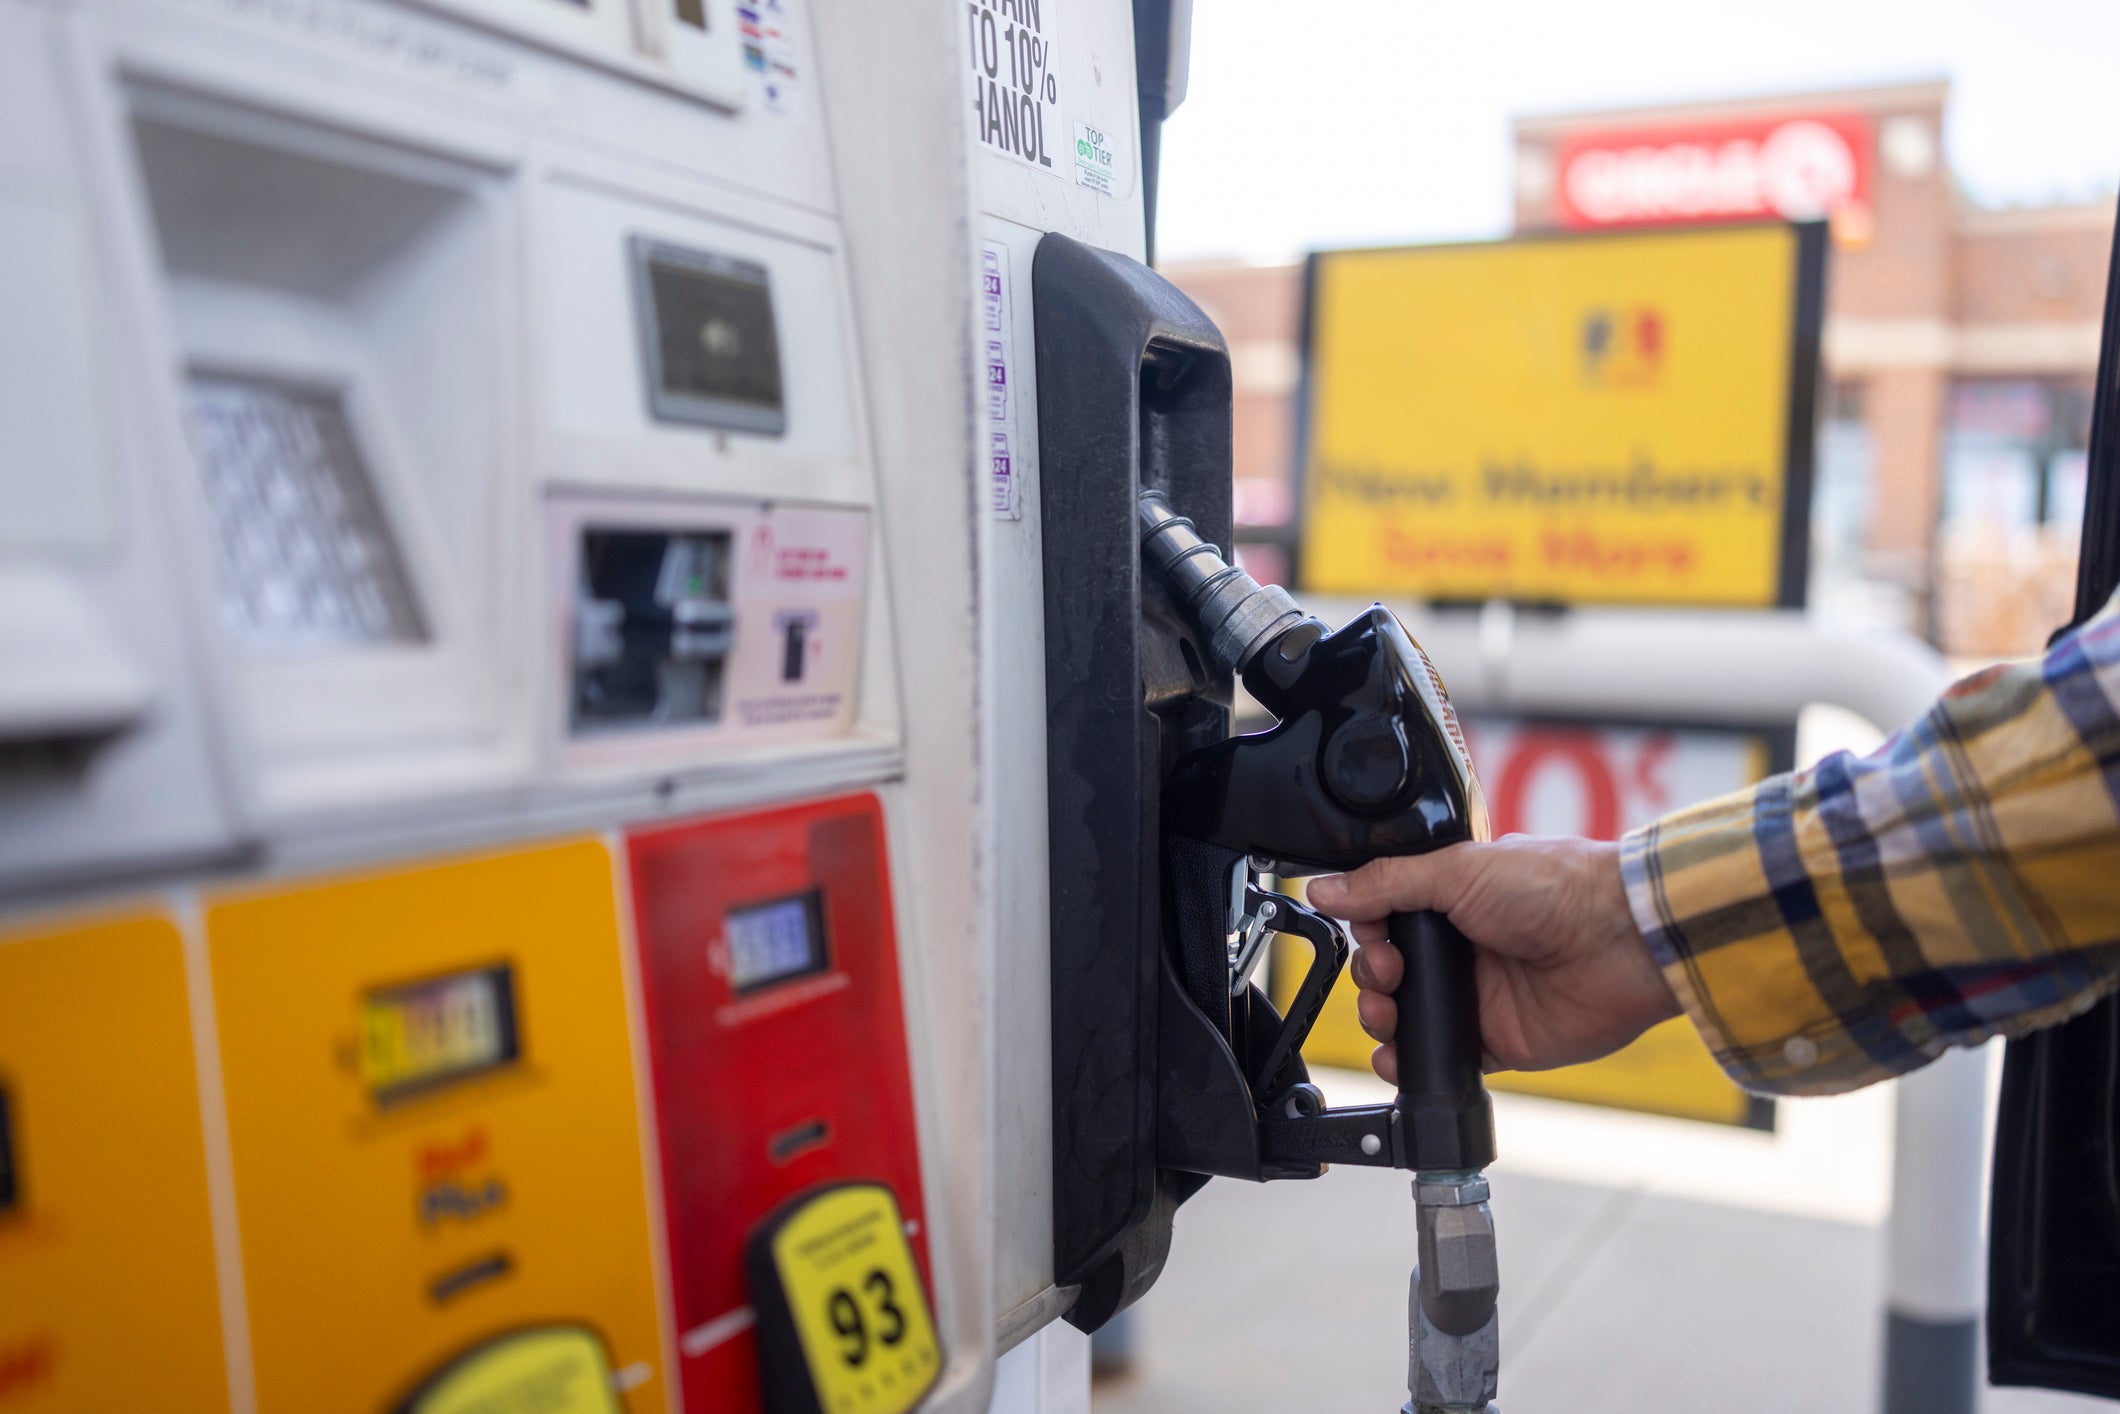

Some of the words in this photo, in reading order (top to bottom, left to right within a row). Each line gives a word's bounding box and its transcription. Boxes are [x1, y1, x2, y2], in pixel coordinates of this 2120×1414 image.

[968, 2, 997, 79] TO
[1004, 22, 1056, 105] 10%
[1085, 126, 1104, 147] TOP
[1093, 145, 1112, 168] TIER
[993, 459, 1007, 475] 24
[828, 1268, 907, 1368] 93
